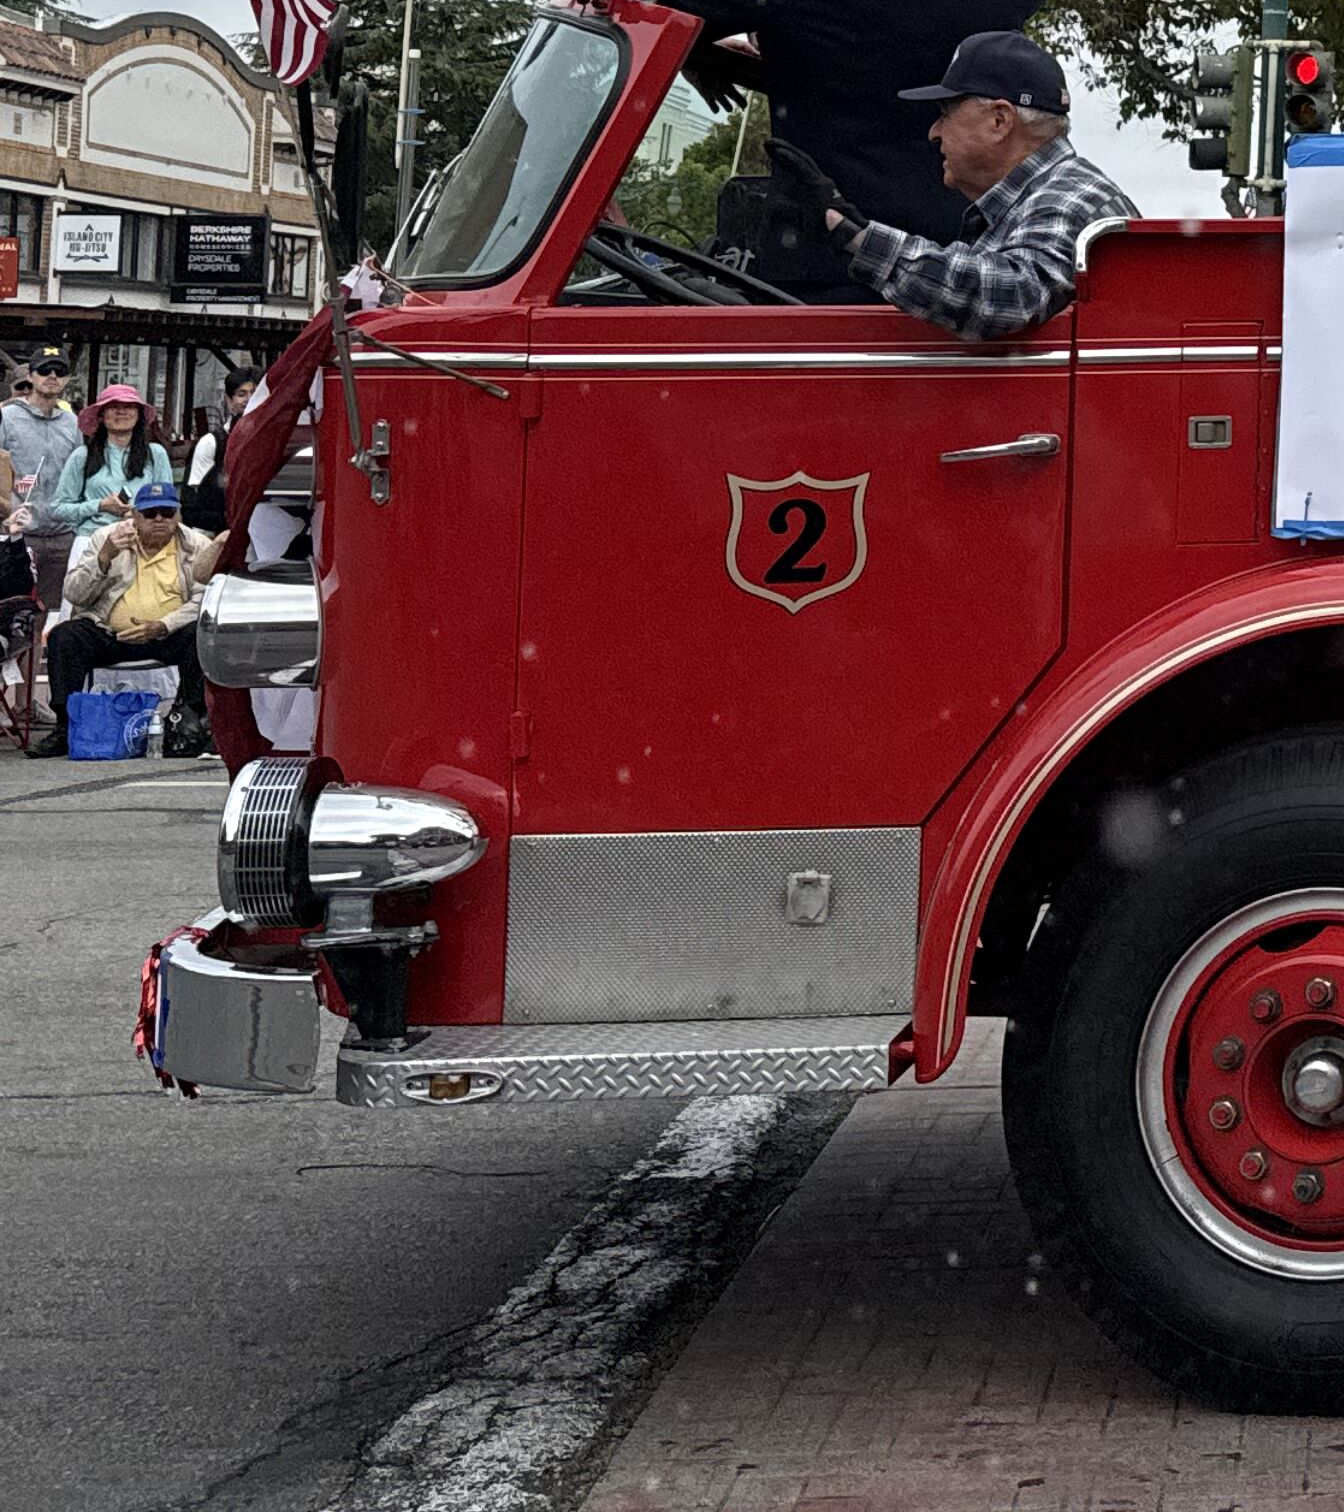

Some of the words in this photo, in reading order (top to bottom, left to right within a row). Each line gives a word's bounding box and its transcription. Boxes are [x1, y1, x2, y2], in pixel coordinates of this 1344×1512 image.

[63, 231, 94, 243] ISLAND
[94, 231, 114, 243] CITY
[189, 234, 252, 243] HATHAWAY
[763, 498, 827, 585] 2
